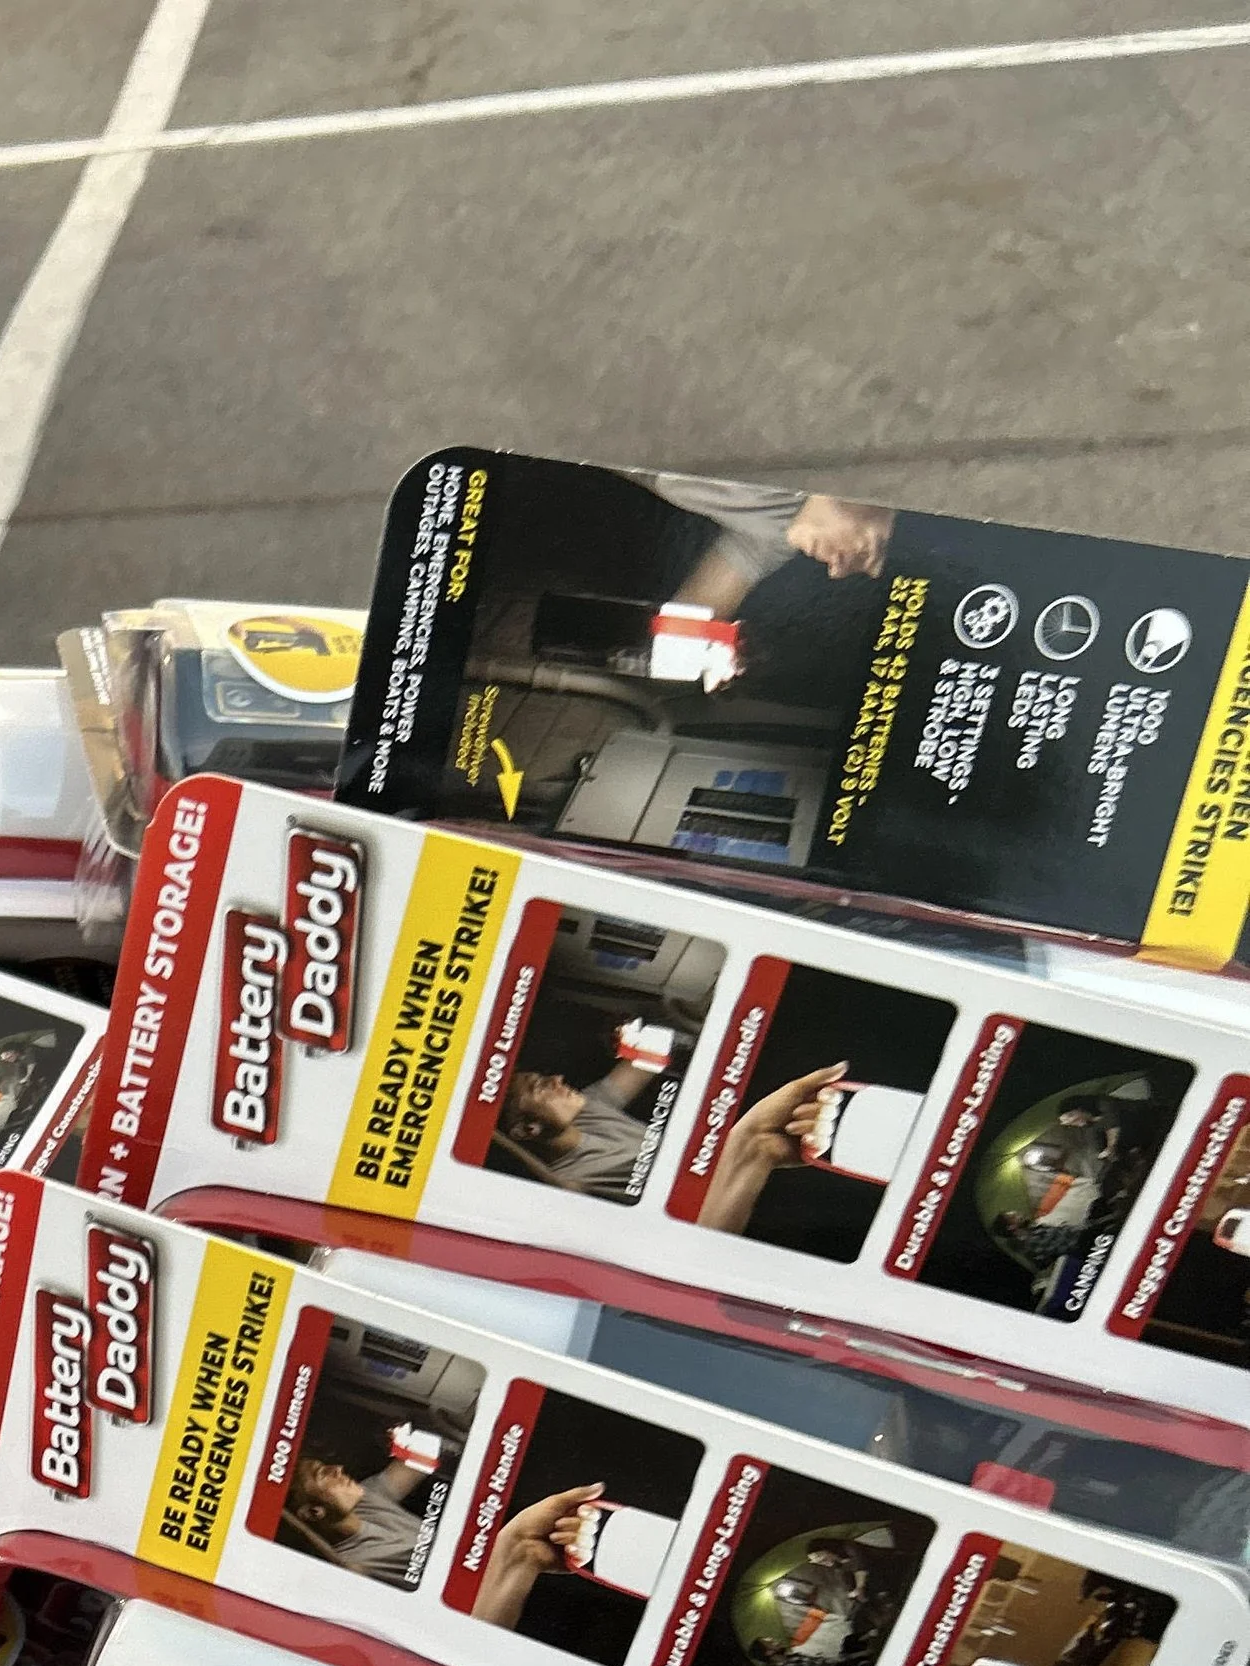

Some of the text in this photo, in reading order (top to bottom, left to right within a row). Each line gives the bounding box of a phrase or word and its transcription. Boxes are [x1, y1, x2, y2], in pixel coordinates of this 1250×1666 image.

[394, 462, 464, 744] HOME, EMERGENCIES, POWER
[445, 467, 488, 605] GREAT FOR:
[367, 460, 446, 795] OUTAGES, CAMPING, BOATS & MORE
[858, 576, 929, 792] HOLDS 42 BATTERIES
[1005, 670, 1041, 728] LEDS
[825, 574, 910, 846] 23 AAs, 17 AAAs, (2) 9 VOLT
[913, 657, 963, 769] & STROBE
[928, 661, 982, 781] HIGH, LOW
[946, 663, 1001, 790] 3 SETTINGS
[1015, 672, 1062, 769] LASTING
[1043, 675, 1082, 739] LONG
[1085, 682, 1132, 774] LUMENS
[1085, 683, 1150, 848] ULTRA-BRIGHT
[1135, 686, 1172, 746] 1000
[1167, 799, 1223, 919] STRIKE!
[108, 981, 169, 1137] BATTERY
[142, 797, 208, 979] STORAGE!
[288, 847, 360, 1038] Daddy
[220, 921, 291, 1132] Battery
[353, 938, 443, 1180] BE READY WHEN
[387, 865, 498, 1189] EMERGENCIES STRIKE!
[477, 963, 535, 1104] 1000 Lumens
[689, 1004, 766, 1176] Non-Slip Handle
[624, 1078, 678, 1197] EMERGENCIES
[894, 1023, 1016, 1271] Durable & Long-Lasting
[1121, 1094, 1246, 1320] Rugged Construction
[94, 1240, 153, 1410] Daddy
[1064, 1232, 1115, 1312] CAMPING
[40, 1302, 93, 1488] Battery
[160, 1331, 230, 1542] BE READY WHEN
[185, 1270, 276, 1552] EMERGENCIES STRIKE!
[267, 1363, 312, 1485] 1000 Lumens
[404, 1479, 448, 1584] EMERGENCIES
[461, 1421, 524, 1572] Non-Slip Handle
[693, 1462, 760, 1591] Long-Lasting
[686, 1590, 707, 1609] &
